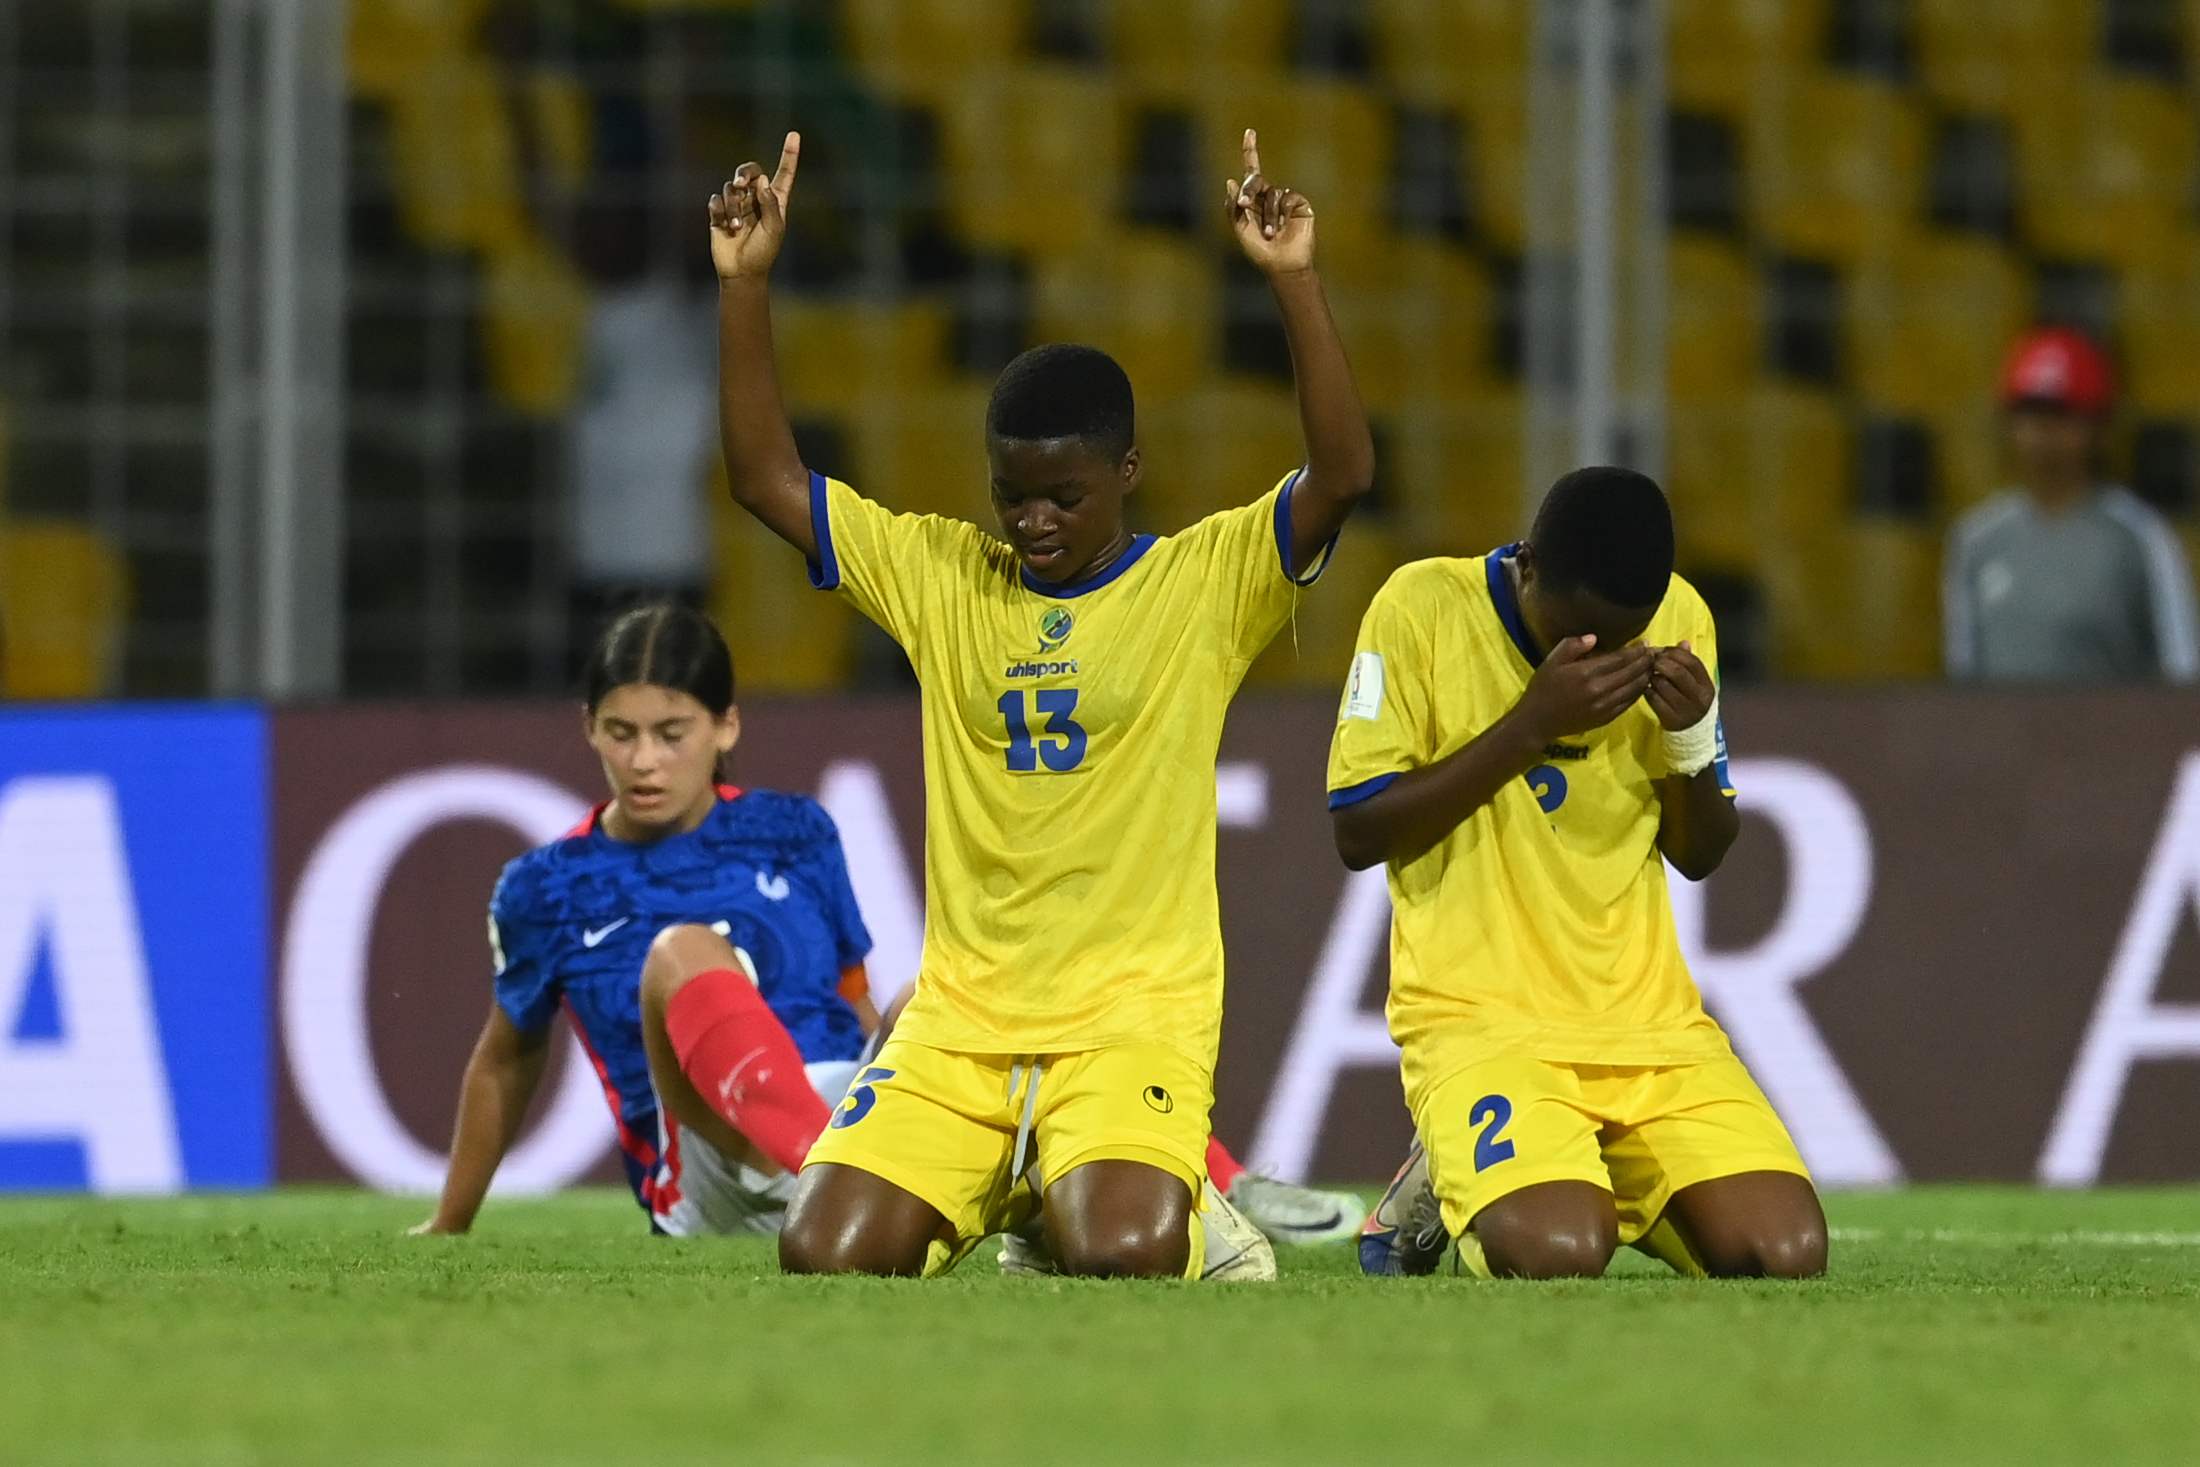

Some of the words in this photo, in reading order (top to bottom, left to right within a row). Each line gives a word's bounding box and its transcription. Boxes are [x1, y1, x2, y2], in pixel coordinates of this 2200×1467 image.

[1005, 659, 1078, 678] uhlsport
[998, 689, 1088, 771] 13
[1469, 1094, 1516, 1174] 2
